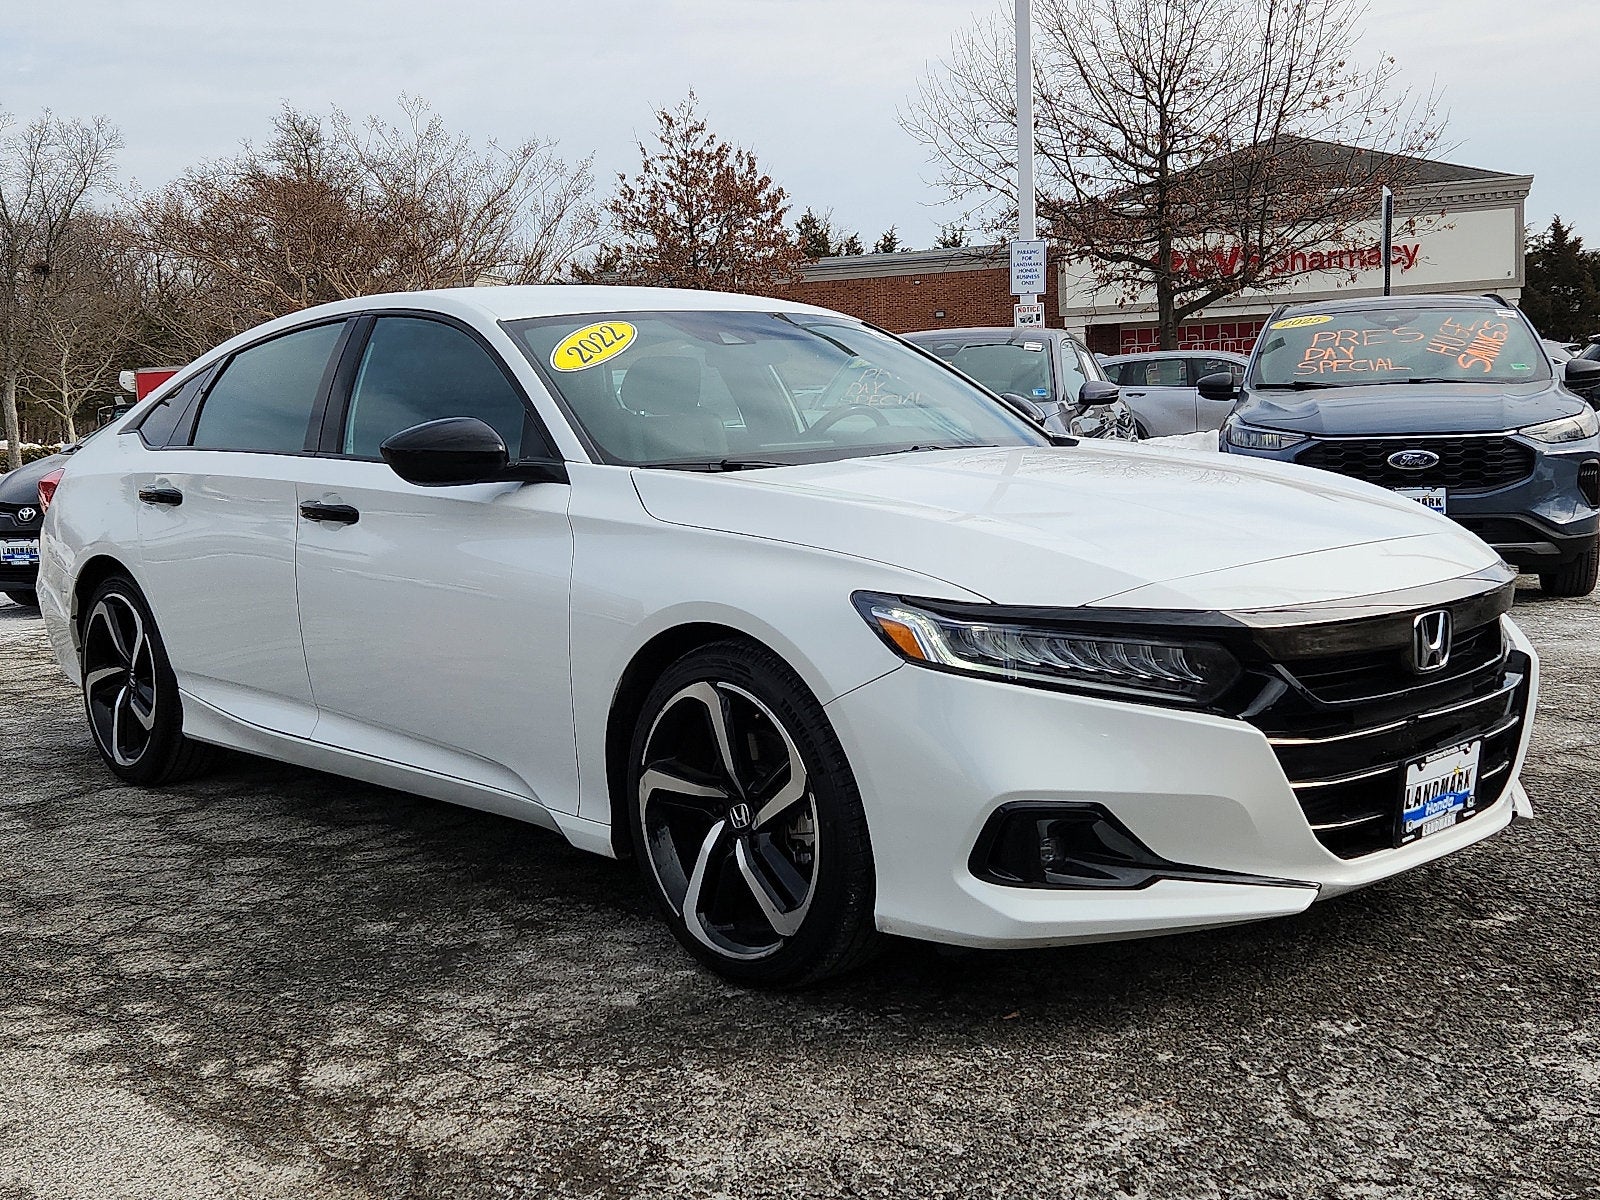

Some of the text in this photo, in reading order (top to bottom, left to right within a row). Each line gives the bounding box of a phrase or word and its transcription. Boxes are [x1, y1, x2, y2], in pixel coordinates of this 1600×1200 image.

[1271, 243, 1421, 274] pharmacy
[1281, 317, 1322, 328] 2025
[566, 325, 626, 364] 2022
[1310, 325, 1425, 348] PRES
[1304, 345, 1355, 361] DAY
[1293, 357, 1412, 375] SPECIAL
[2, 547, 38, 555] LANDMARK
[1405, 767, 1472, 810] LANDMARK
[1425, 795, 1455, 816] Honda
